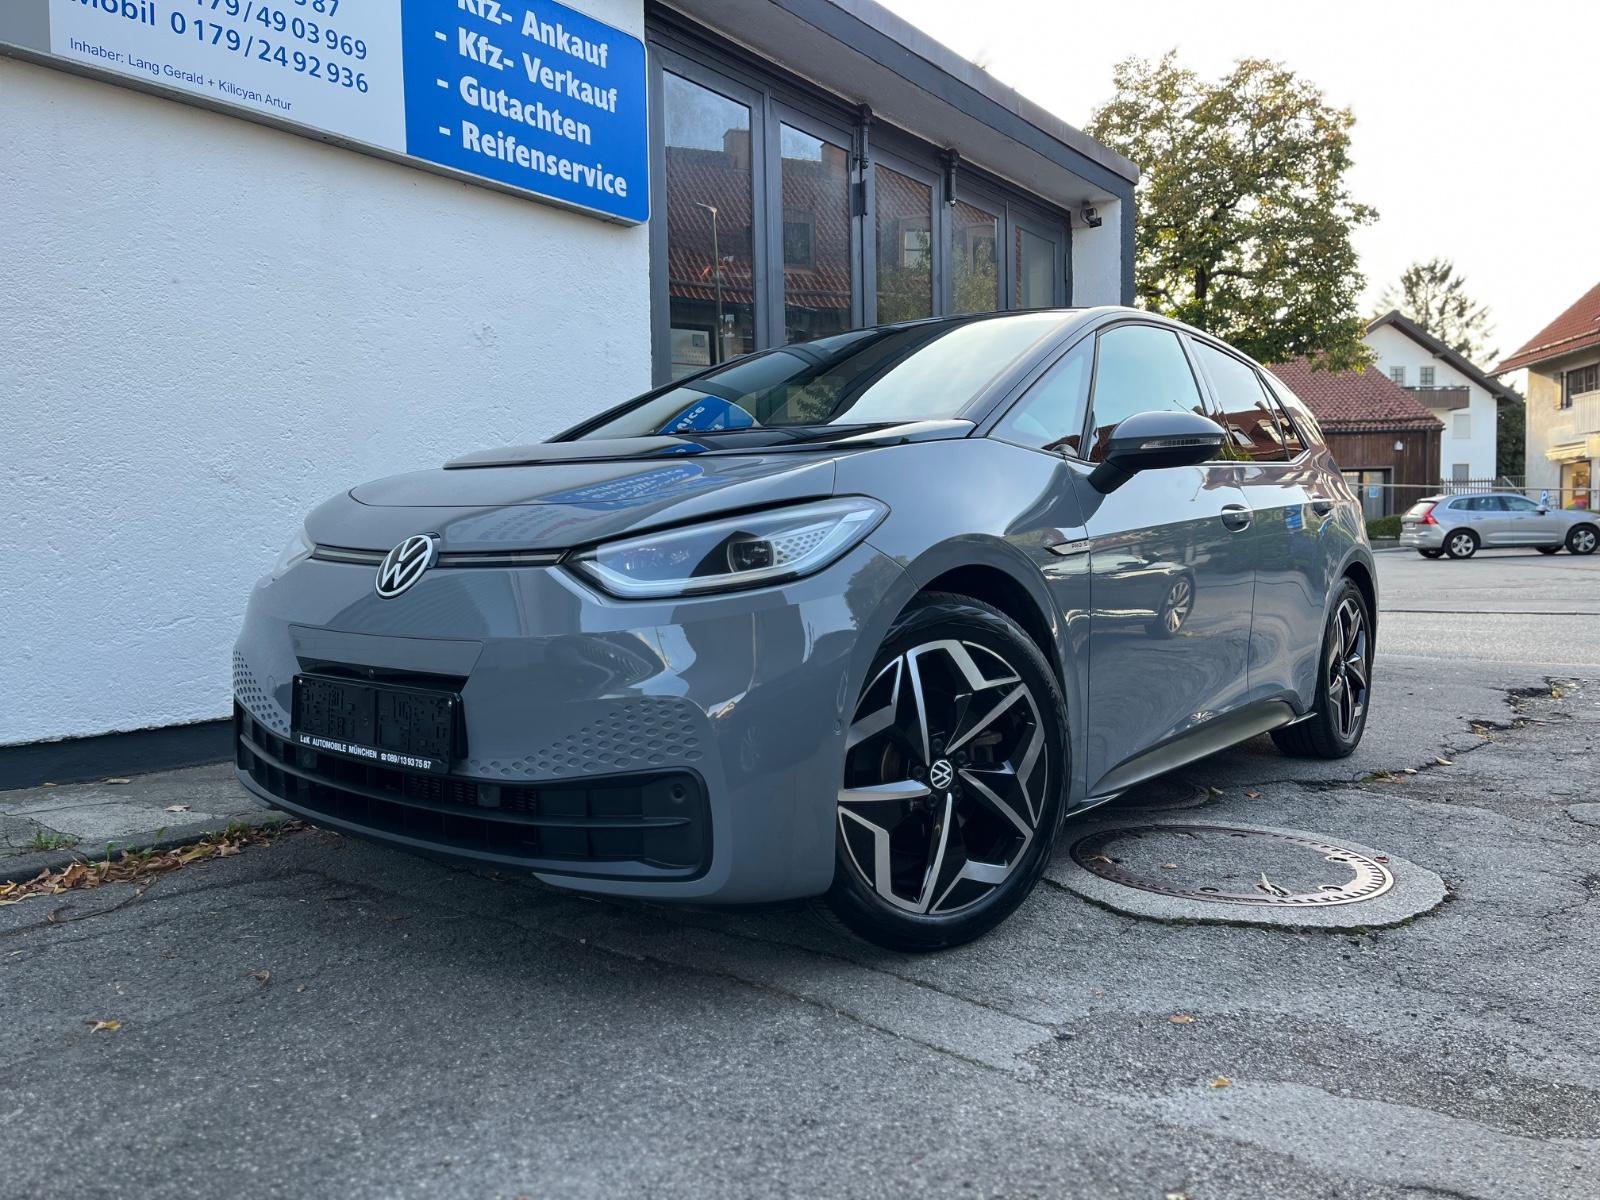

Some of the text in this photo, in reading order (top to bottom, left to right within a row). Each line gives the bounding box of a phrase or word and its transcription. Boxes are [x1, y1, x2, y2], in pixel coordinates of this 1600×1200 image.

[72, 0, 155, 26] obil
[521, 10, 608, 69] Ankauf
[70, 37, 124, 63] Inhaber:
[128, 54, 160, 75] Lang
[163, 64, 204, 85] Gerald
[218, 79, 262, 102] Kilicyan
[265, 94, 292, 111] Artur
[458, 26, 514, 71] Kfz-
[522, 52, 618, 113] Verkauf
[459, 75, 592, 146] Gutachten
[461, 120, 628, 198] Reifenservice
[312, 737, 347, 753] AUTOMOBILE
[348, 744, 378, 759] MÜNCHEN
